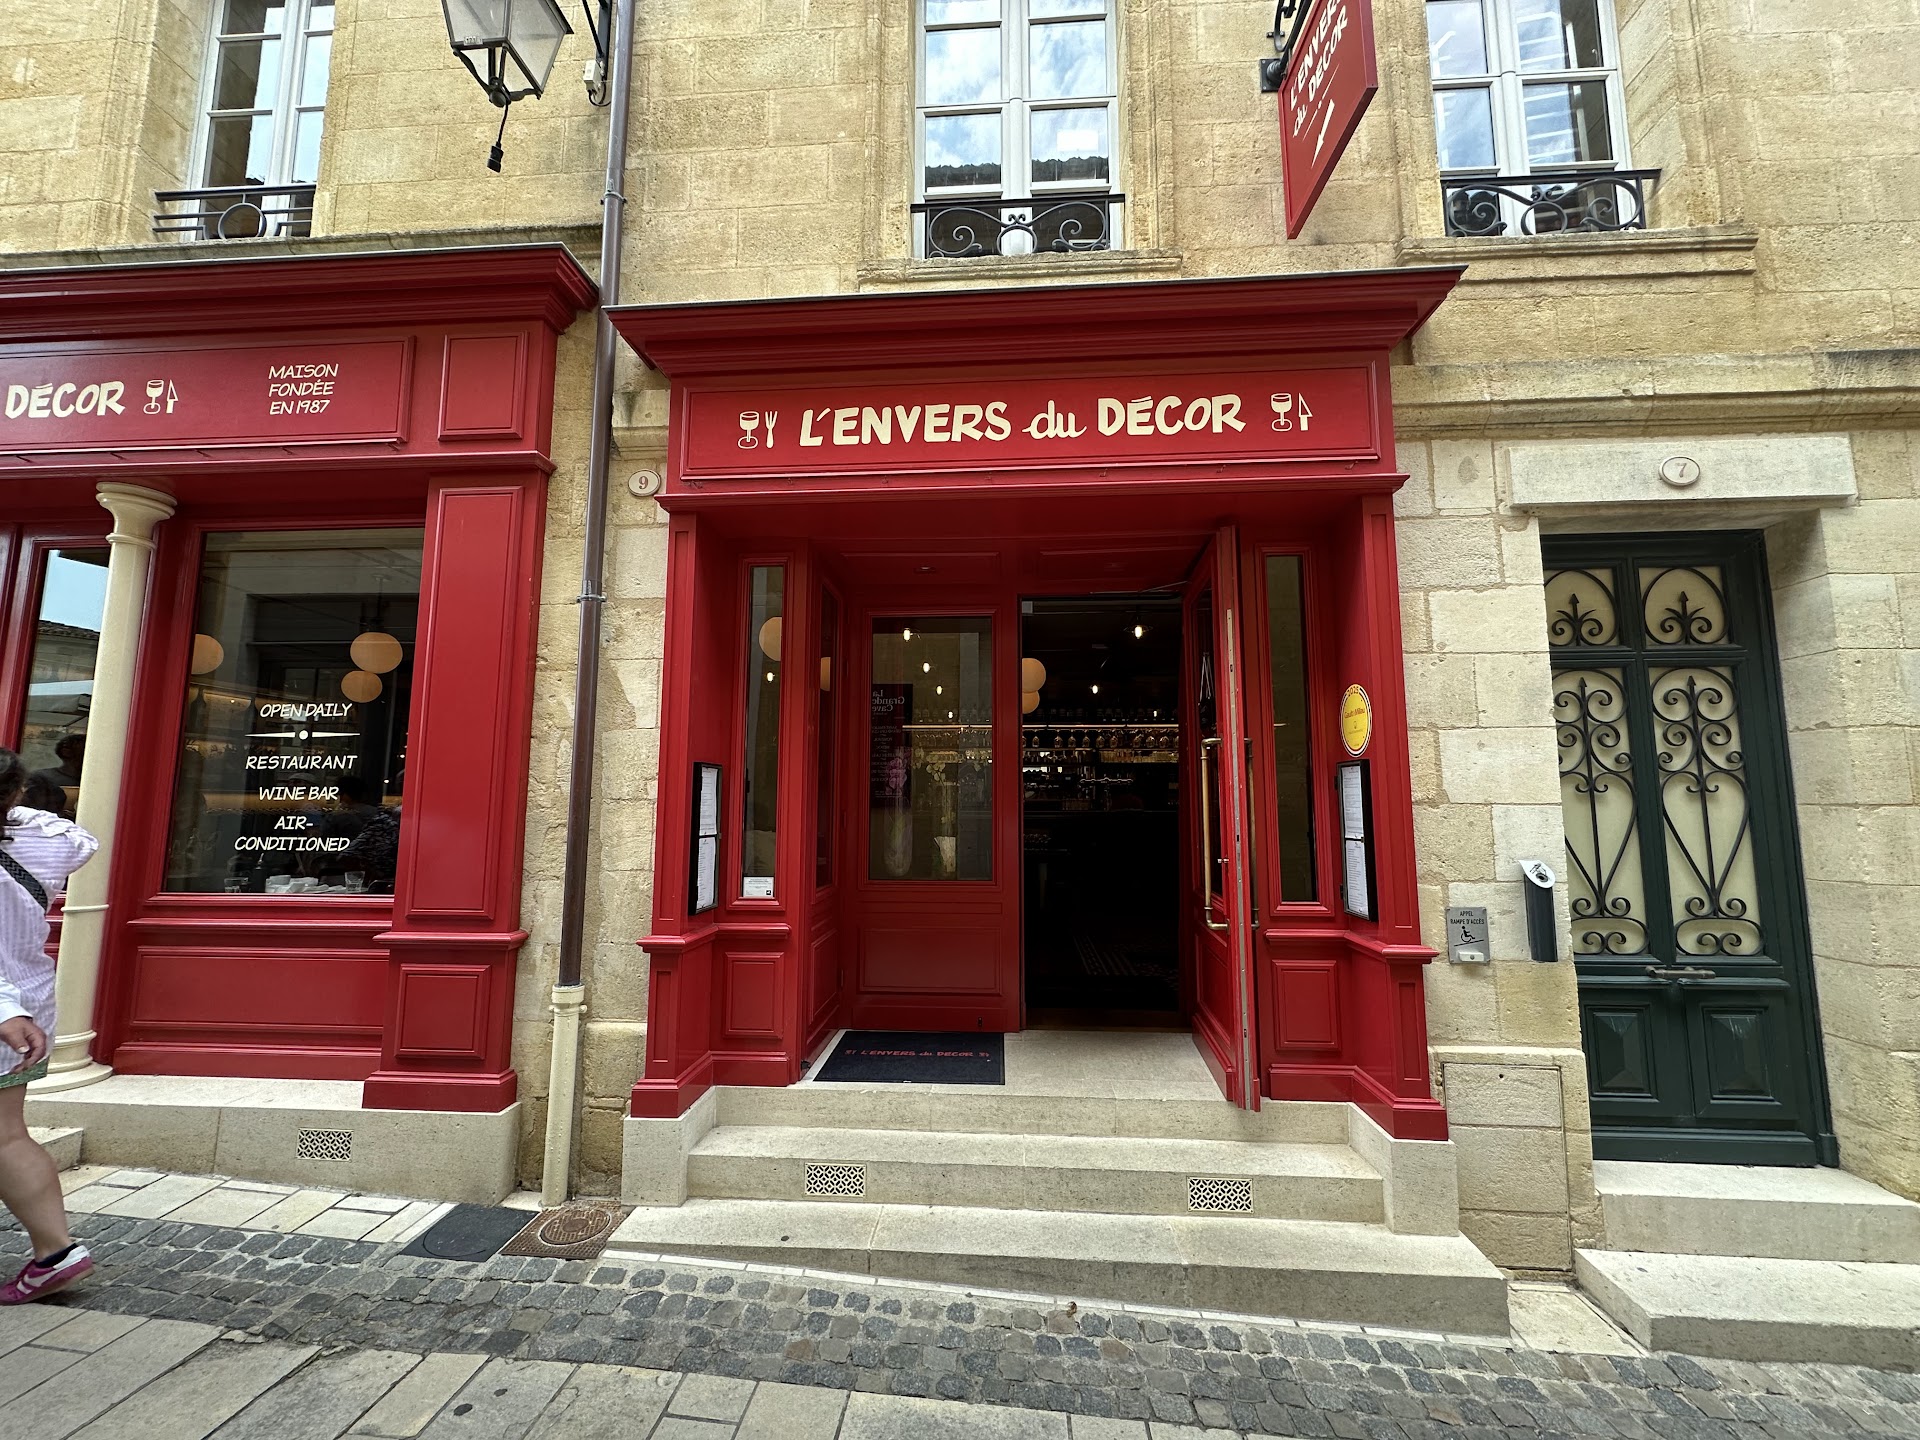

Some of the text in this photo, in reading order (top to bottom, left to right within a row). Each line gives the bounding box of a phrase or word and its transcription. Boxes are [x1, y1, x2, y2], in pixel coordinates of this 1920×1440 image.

[1291, 0, 1340, 111] L'ENVER
[1293, 104, 1308, 138] du
[268, 363, 339, 379] MAISON
[268, 379, 335, 397] FONDÉE
[4, 381, 125, 419] DÉCOR
[269, 400, 330, 415] EN 1987
[799, 394, 1246, 446] L'ENVERS du DÉCOR
[1675, 462, 1687, 478] 7
[638, 475, 649, 490] 9
[259, 703, 352, 717] OPEN DAILY
[245, 755, 357, 770] RESTAURANT
[259, 786, 339, 800] WINE BAR
[274, 816, 314, 830] AIR-
[234, 836, 350, 851] CONDITIONED
